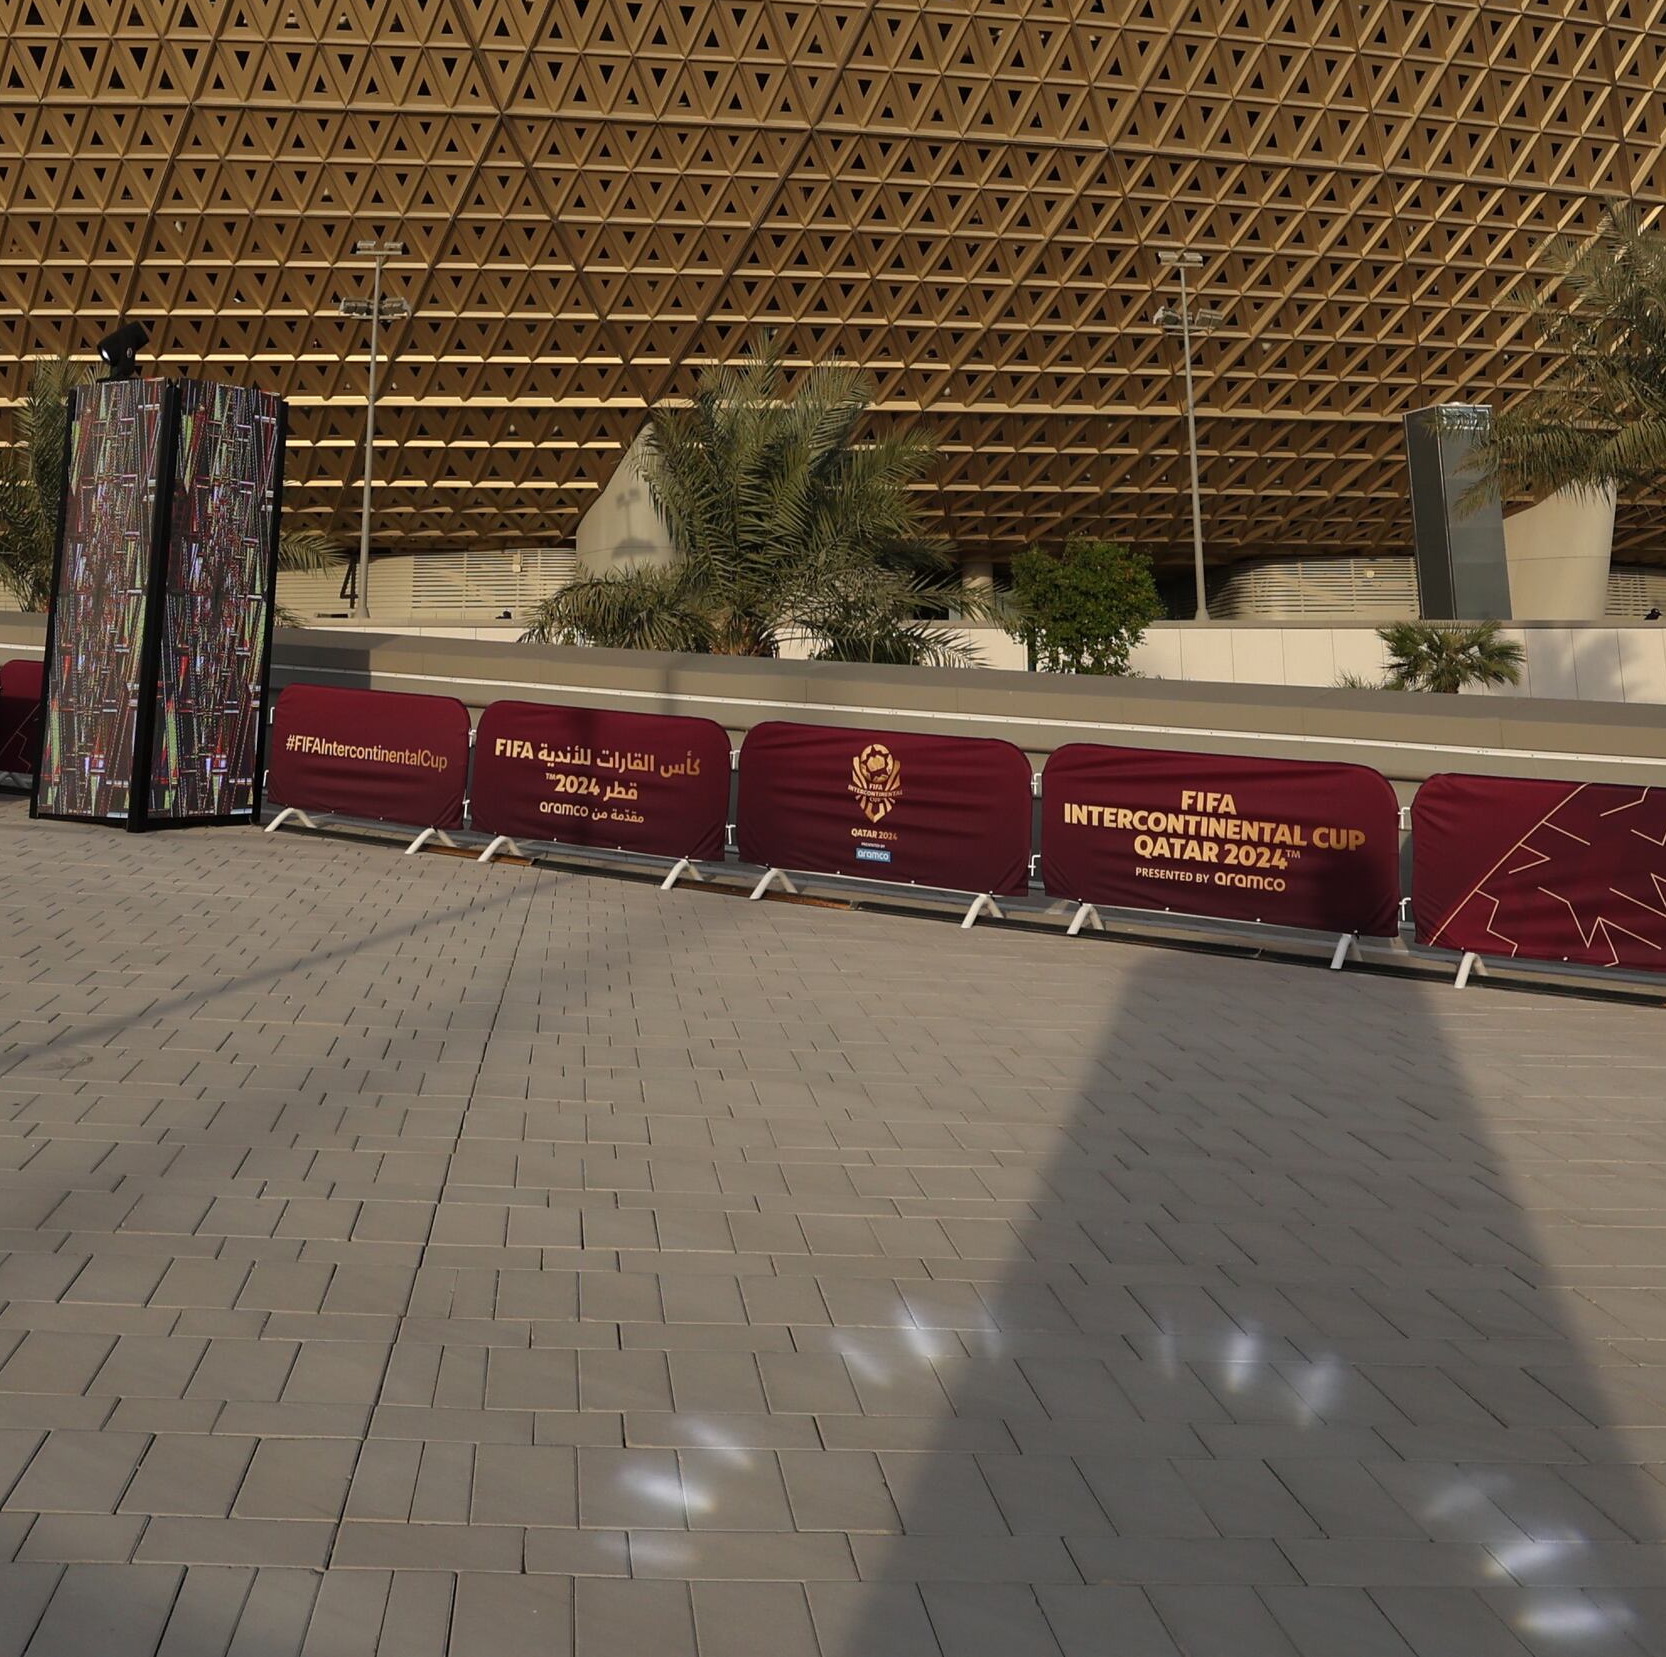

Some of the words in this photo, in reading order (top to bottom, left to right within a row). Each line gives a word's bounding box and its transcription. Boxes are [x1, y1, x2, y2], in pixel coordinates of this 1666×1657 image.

[339, 549, 359, 609] 4
[286, 734, 448, 772] #FIFAIntercontinentalCup
[495, 738, 533, 759] FIFA
[538, 743, 591, 767] للأندية
[597, 749, 654, 773] القارات
[660, 750, 701, 778] كأس
[603, 781, 638, 801] قطر
[1181, 790, 1237, 815] FIFA
[539, 801, 588, 817] aramco
[592, 808, 608, 820] من
[851, 828, 877, 839] QATAR
[878, 831, 898, 840] 2024
[1064, 803, 1307, 846] INTERCONTINENTAL
[1312, 827, 1366, 851] CUP
[857, 849, 889, 860] aramco
[1134, 835, 1219, 863] QATAR
[1135, 867, 1193, 882] PRESENTED
[1196, 873, 1210, 883] BY
[1214, 871, 1286, 892] aramco
